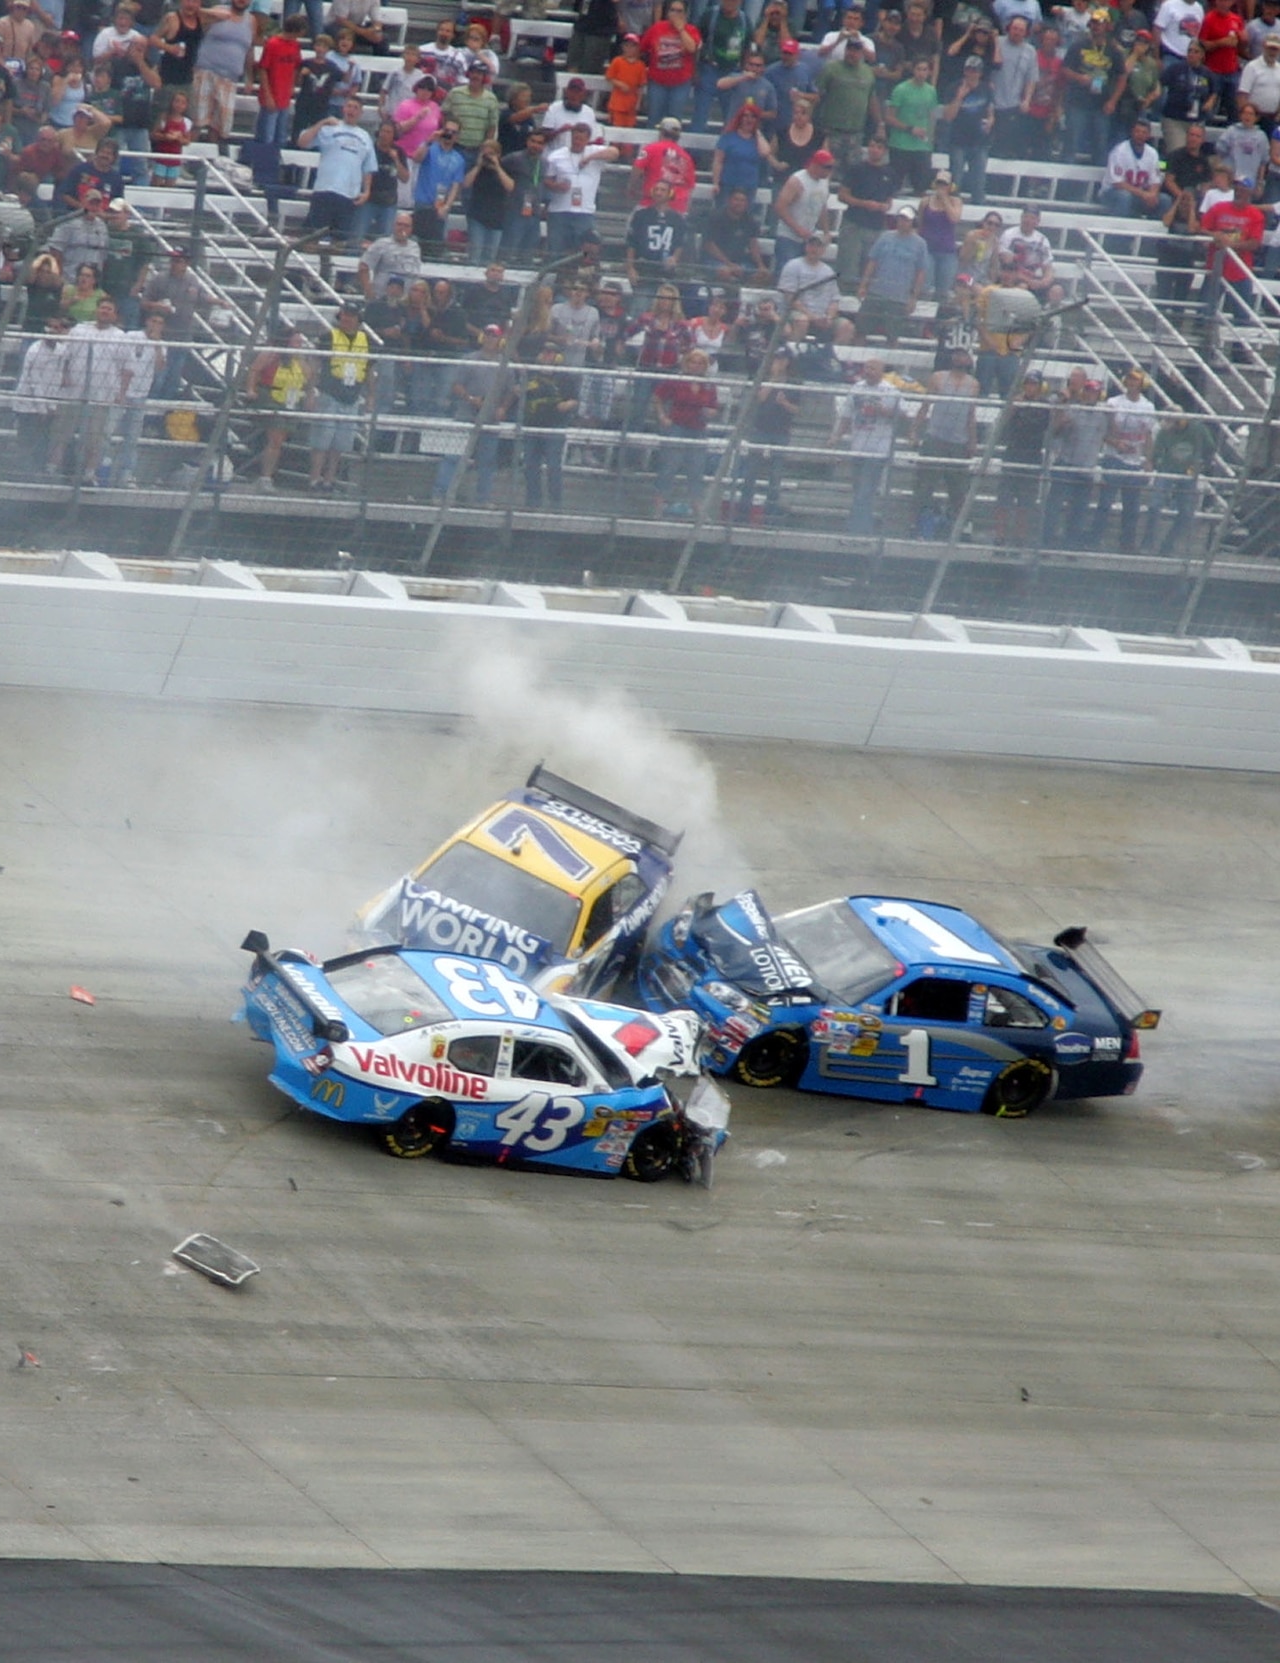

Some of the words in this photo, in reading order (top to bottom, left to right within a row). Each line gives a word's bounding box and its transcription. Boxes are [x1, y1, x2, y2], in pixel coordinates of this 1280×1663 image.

[647, 225, 674, 251] 54
[482, 807, 595, 881] 7
[402, 899, 529, 977] WORLD
[405, 880, 541, 954] CAMPING
[870, 902, 1001, 965] 1
[433, 957, 539, 1020] 43
[348, 1046, 489, 1101] Valvoline
[899, 1029, 937, 1086] 1
[1094, 1037, 1121, 1050] MEN
[496, 1092, 586, 1152] 43
